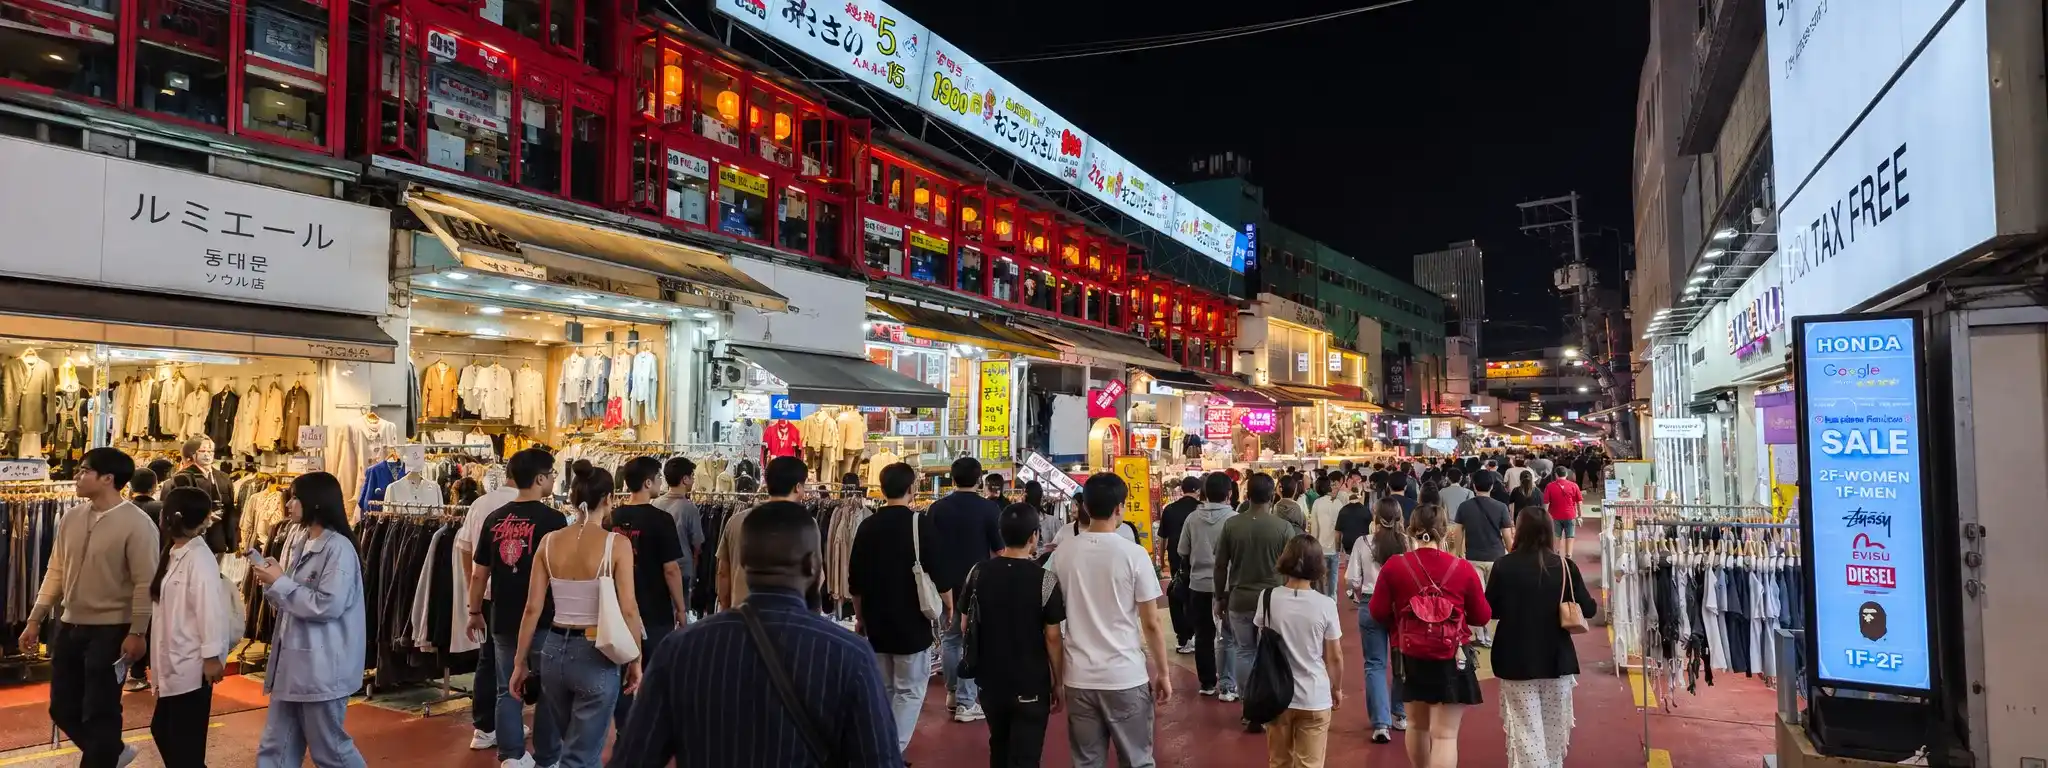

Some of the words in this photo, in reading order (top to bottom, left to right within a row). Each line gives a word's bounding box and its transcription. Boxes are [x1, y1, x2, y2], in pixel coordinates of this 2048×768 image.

[1811, 199, 1844, 267] TAX
[1849, 142, 1910, 243] FREE
[130, 193, 334, 250] ルミエール
[204, 248, 268, 273] 동대문
[206, 272, 266, 290] ソウル店
[1817, 336, 1902, 353] HONDA
[1823, 363, 1880, 379] Google
[1821, 429, 1909, 455] SALE
[1820, 470, 1910, 484] 2F-WOMEN
[1836, 486, 1897, 499] 1F-MEN
[1852, 551, 1890, 561] EVISU
[1848, 566, 1895, 585] DIESEL
[1845, 649, 1904, 669] 1F-2F
